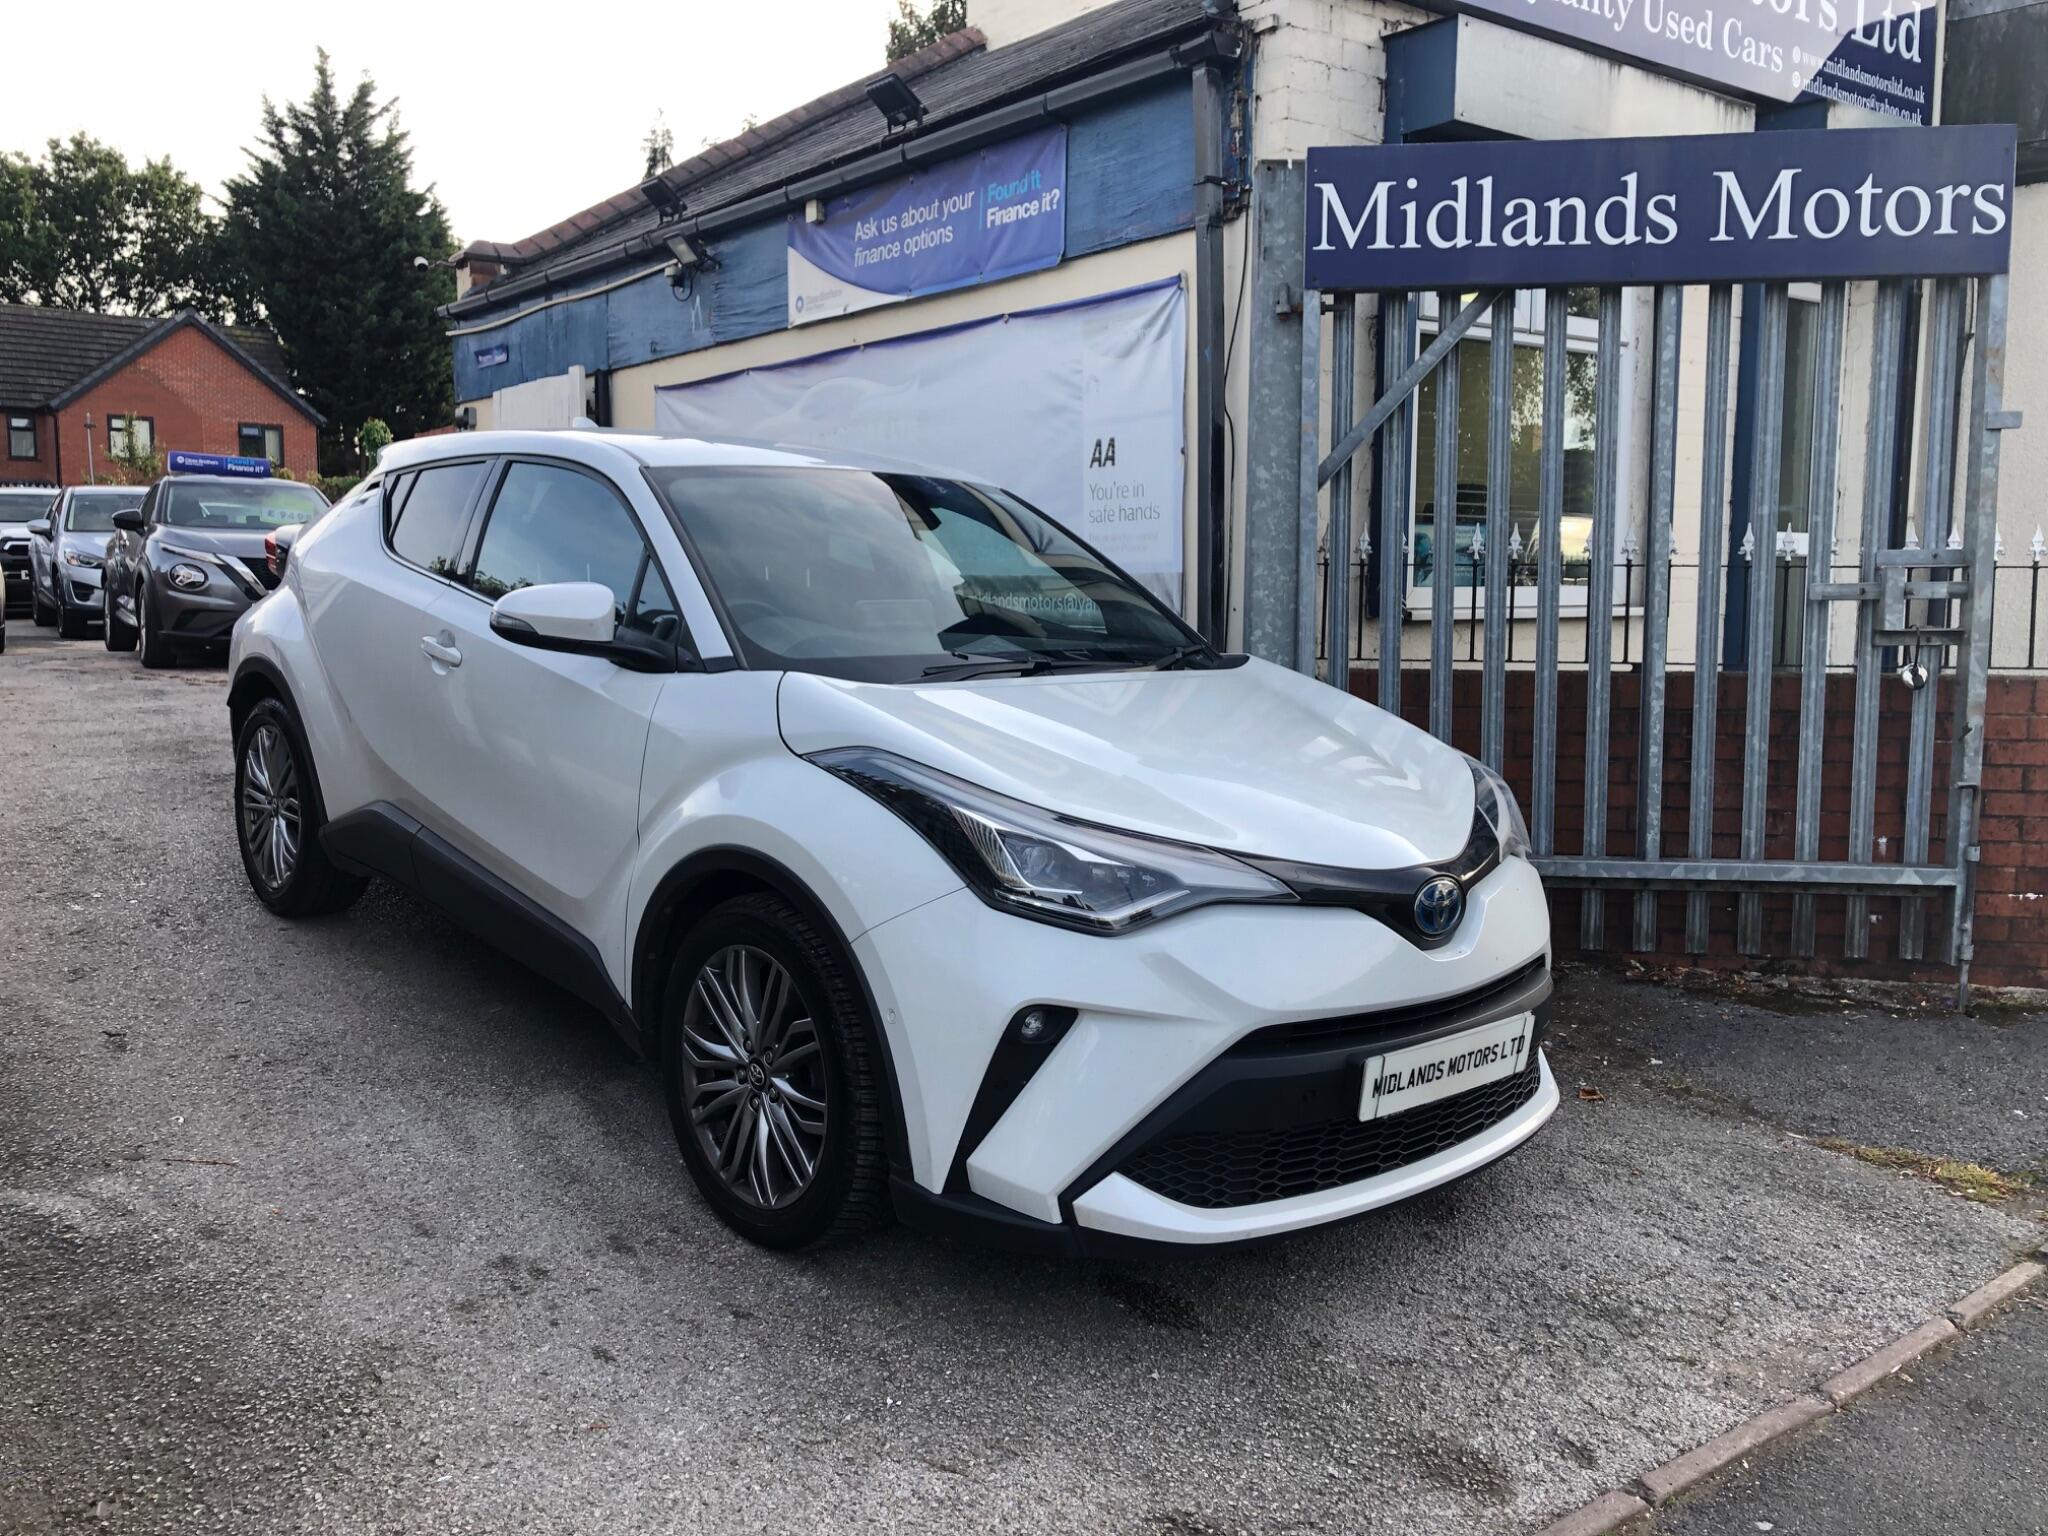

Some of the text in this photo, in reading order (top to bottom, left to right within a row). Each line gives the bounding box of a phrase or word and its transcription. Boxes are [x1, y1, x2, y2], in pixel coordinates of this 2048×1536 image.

[1643, 0, 1713, 51] Used
[1723, 18, 1784, 73] Cars
[1851, 0, 1922, 63] Ltd
[987, 170, 1041, 203] Found it
[854, 190, 975, 242] Ask us about your
[987, 188, 1061, 229] Finance it?
[1312, 167, 2007, 251] Midlands Motors
[854, 225, 953, 268] finance options
[1089, 437, 1116, 469] AA
[1089, 480, 1145, 501] You're in
[1088, 502, 1161, 524] safe hands
[1372, 1034, 1526, 1098] MIDLANDS MOTORS LTD
